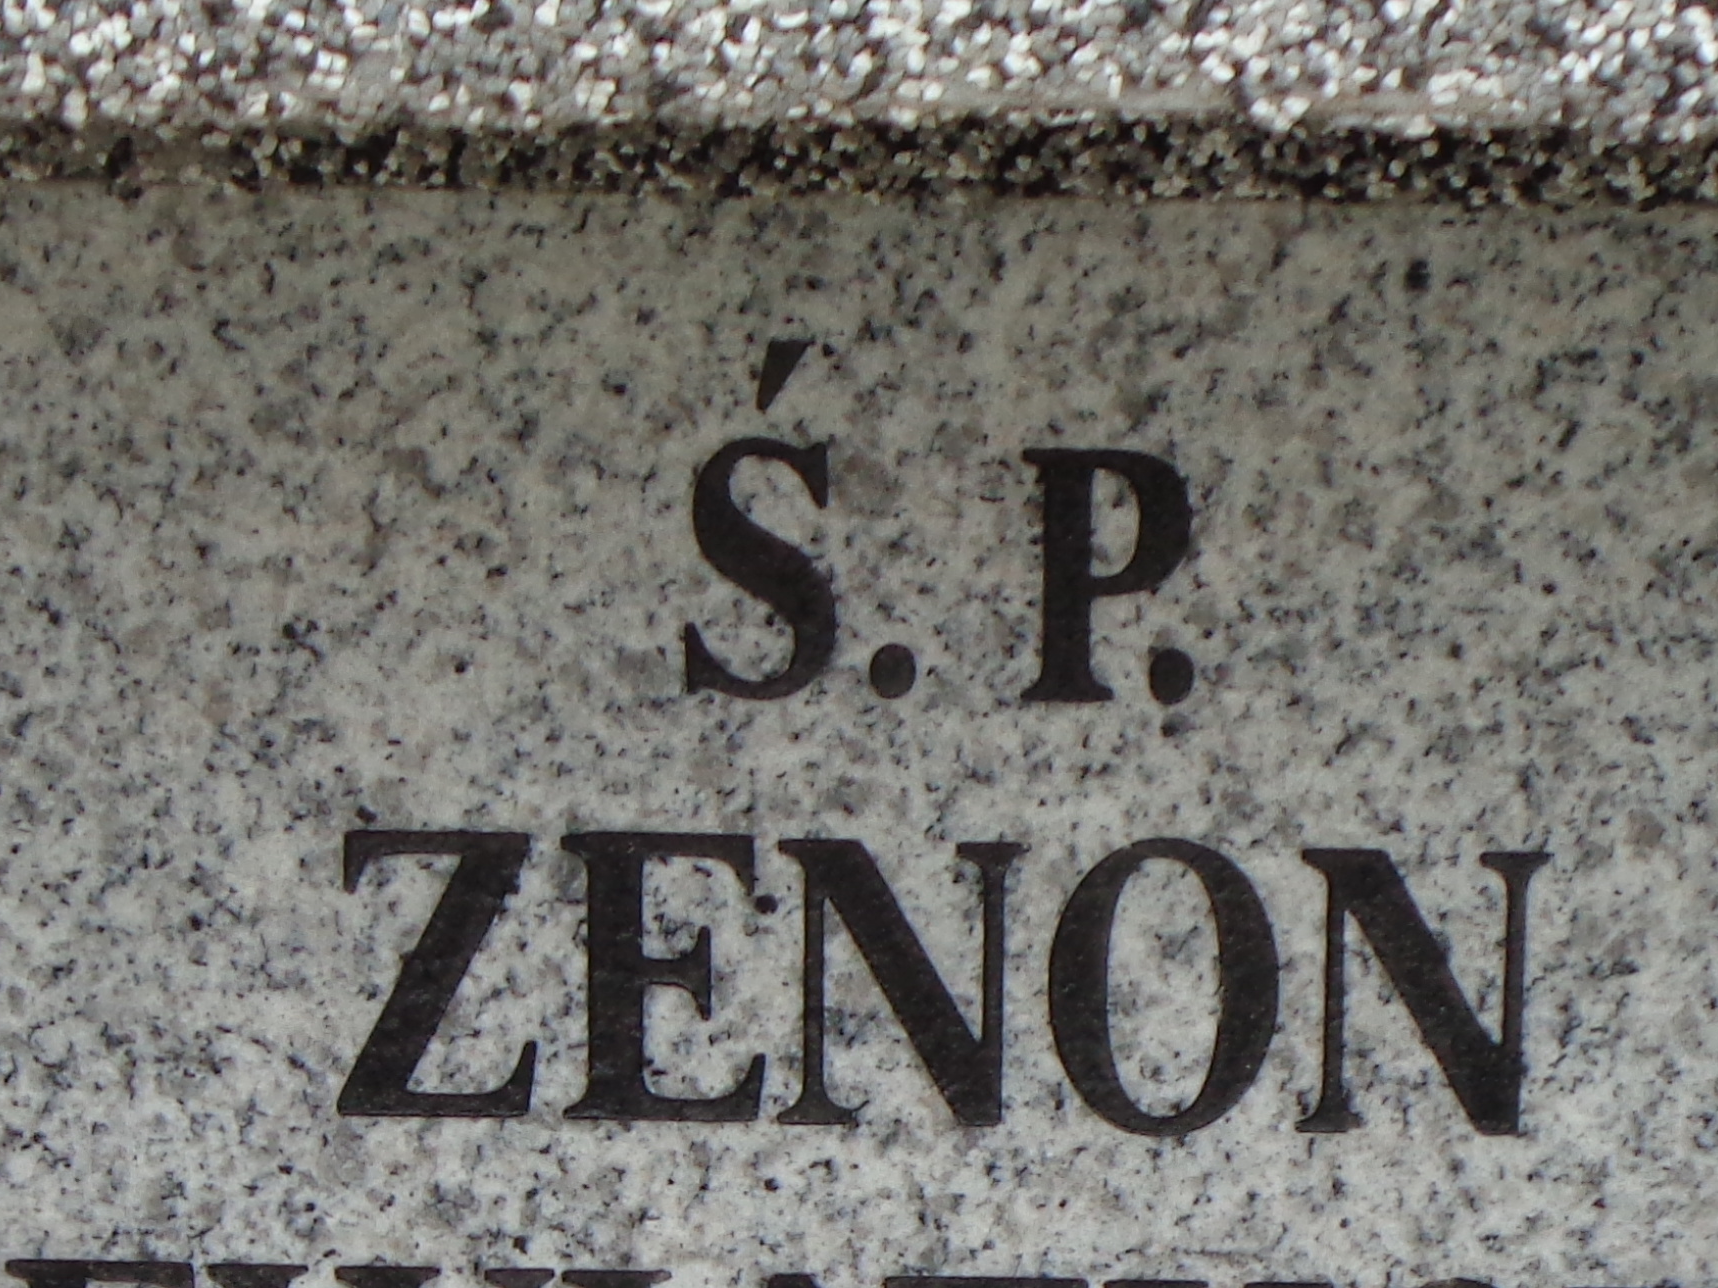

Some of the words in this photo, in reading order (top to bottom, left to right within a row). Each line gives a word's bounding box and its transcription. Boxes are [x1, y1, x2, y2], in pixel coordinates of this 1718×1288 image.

[683, 340, 917, 701] Ś.
[1019, 448, 1195, 706] P.
[336, 829, 1555, 1138] ZENON
